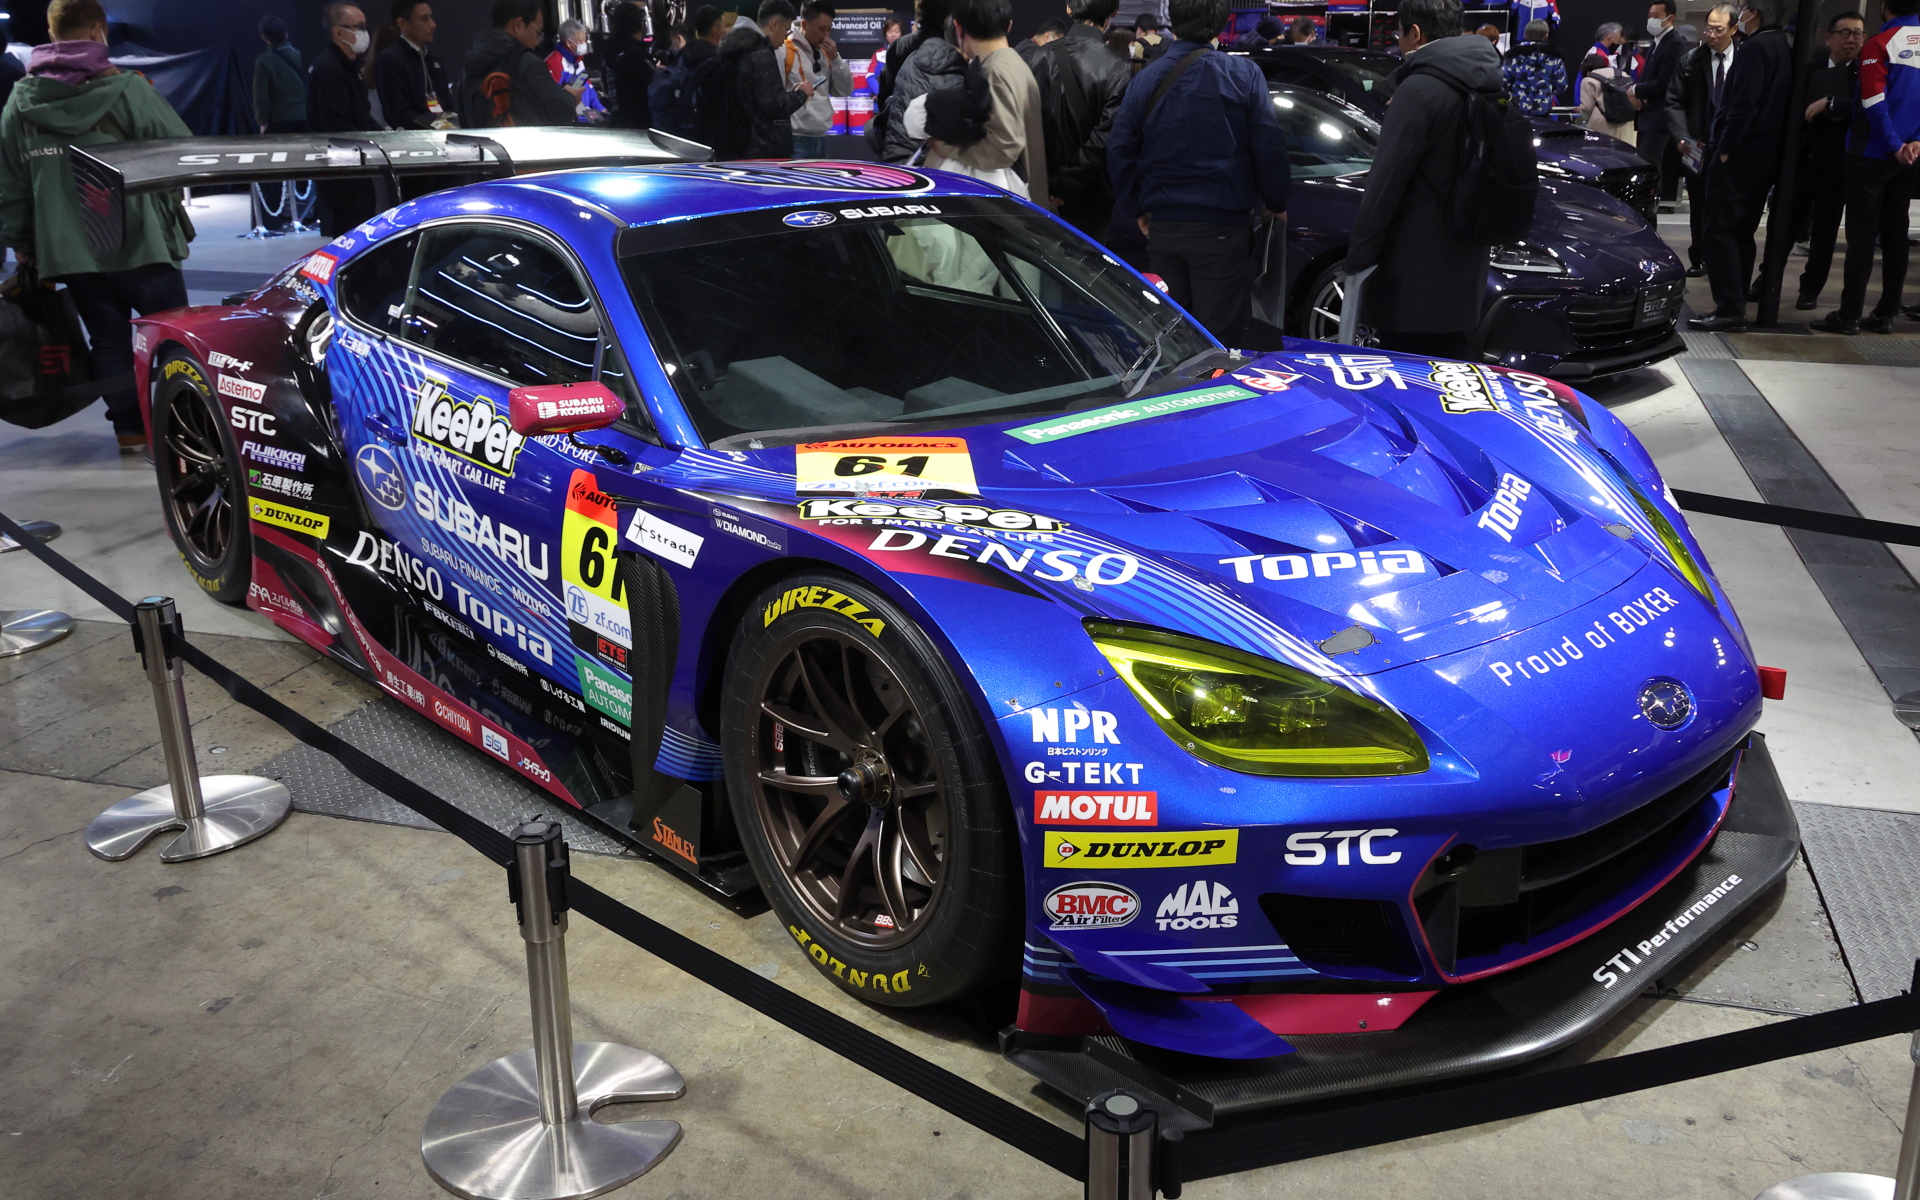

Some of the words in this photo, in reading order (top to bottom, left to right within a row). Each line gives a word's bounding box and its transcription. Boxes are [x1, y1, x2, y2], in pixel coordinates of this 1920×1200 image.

[831, 21, 868, 30] Advanced
[870, 21, 881, 30] Oil
[177, 151, 288, 166] STI
[839, 205, 941, 219] SUBARU
[303, 254, 335, 280] MOTUL
[1643, 298, 1667, 312] BRZ
[219, 377, 262, 400] Astemo
[558, 397, 603, 408] SUBARU
[231, 406, 277, 436] STC
[415, 381, 524, 470] KeePer
[1022, 407, 1140, 439] Panasonic
[1143, 387, 1246, 414] AUTOMOTIVE
[241, 441, 306, 464] FUJIKIKAI
[559, 436, 598, 464] SPORT
[415, 443, 432, 461] FOR
[435, 451, 463, 475] SMART
[464, 464, 482, 486] CAR
[483, 473, 507, 495] LIFE
[834, 456, 930, 477] 61
[262, 473, 314, 496] 石原製作所
[264, 507, 323, 530] DUNLOP
[722, 512, 739, 521] SUBARU
[808, 499, 1064, 530] KeePer
[413, 481, 549, 580] SUBARU
[649, 528, 696, 557] Strada
[819, 518, 863, 526] FOR
[871, 518, 945, 531] SMART
[953, 524, 998, 538] CAR
[1004, 532, 1054, 543] LIFE
[346, 530, 443, 601] DENSO
[421, 537, 457, 567] SUBARU
[459, 560, 502, 595] FINANCE
[579, 527, 627, 602] 61
[867, 528, 1140, 585] DENSO
[316, 558, 344, 605] SUBARU
[595, 612, 631, 640] zf.com
[764, 585, 886, 639] DIREZZA
[598, 638, 626, 663] ETS
[1489, 636, 1583, 687] Proud
[1586, 622, 1611, 648] of
[1613, 587, 1681, 633] BOXER
[442, 705, 471, 734] CHIYODA
[600, 717, 631, 741] IRIDIUM
[1031, 708, 1121, 744] NPR
[775, 722, 783, 751] BBS
[1047, 747, 1108, 756] 日本ピストンリング
[1024, 762, 1144, 784] G-TEKT
[1040, 796, 1152, 820] MOTUL
[652, 816, 697, 865] STANLEY
[1084, 840, 1226, 858] DUNLOP
[1284, 828, 1402, 866] STC
[1056, 895, 1129, 915] BMC
[1156, 881, 1239, 918] MAC
[1055, 915, 1090, 926] Air
[1091, 916, 1122, 924] Filter
[1155, 915, 1238, 931] TOOLS
[1592, 948, 1640, 989] STI
[1636, 873, 1743, 957] Performance
[789, 923, 912, 994] DUNLOP
